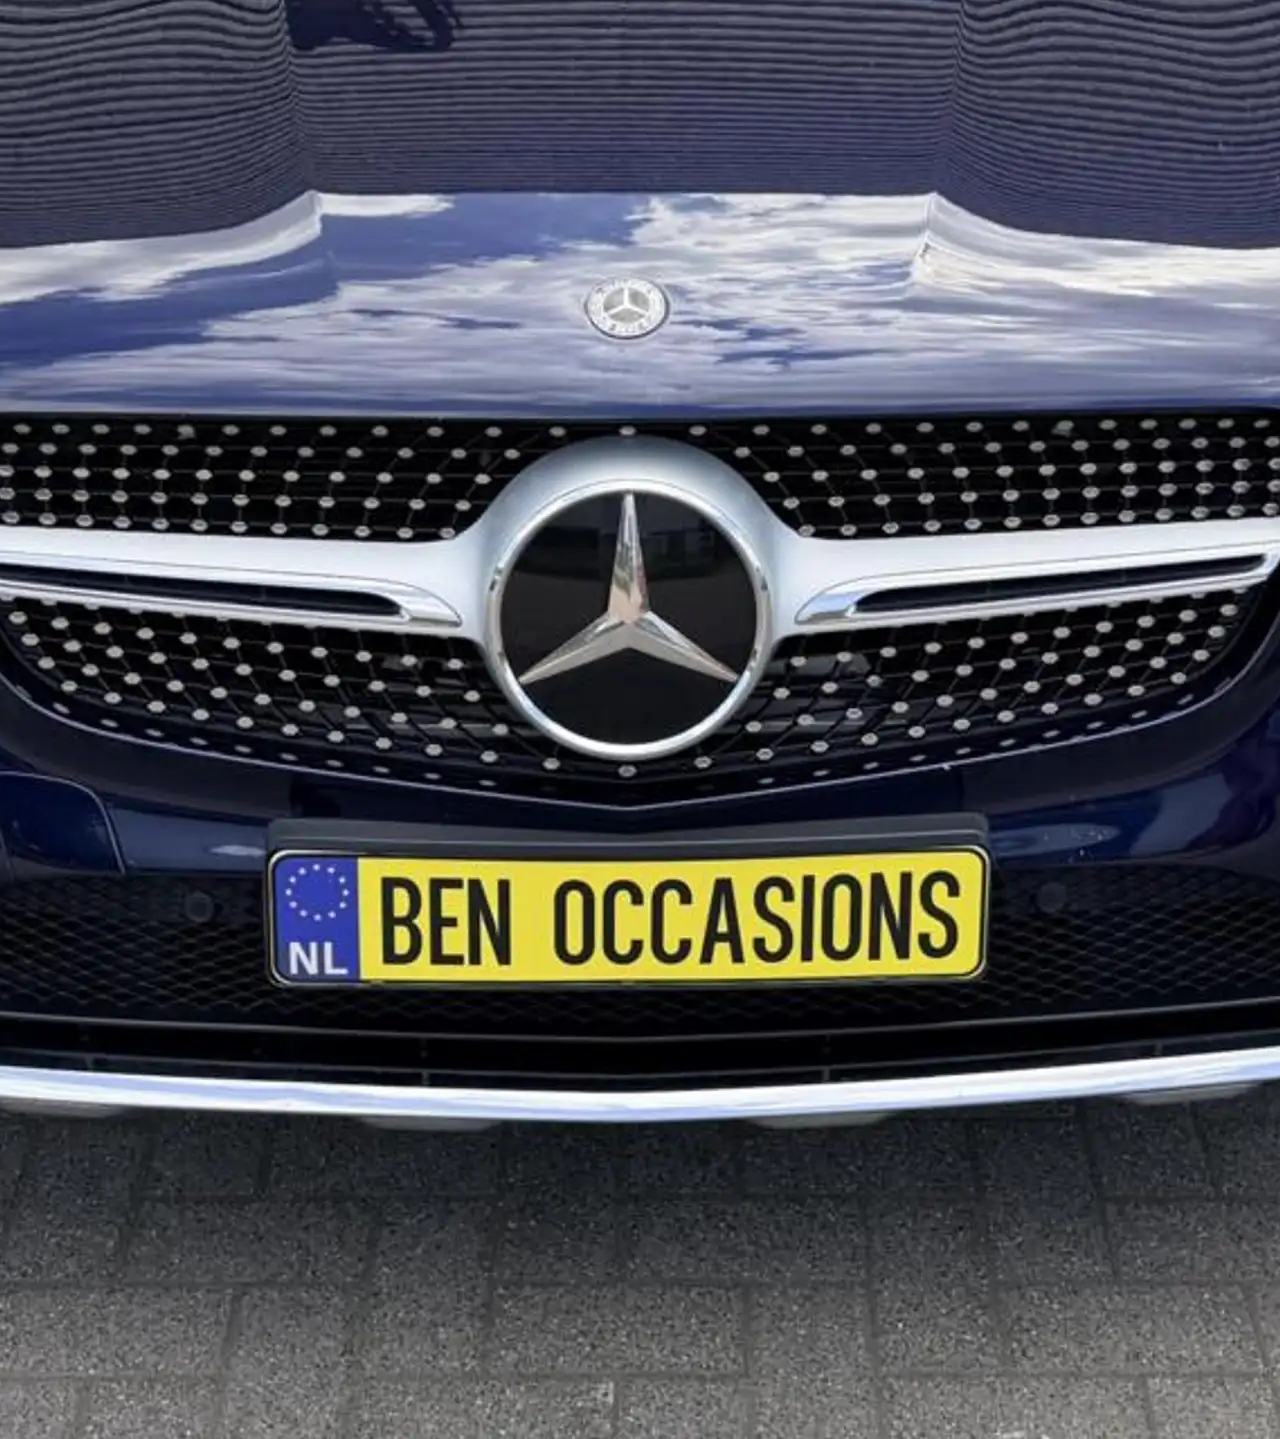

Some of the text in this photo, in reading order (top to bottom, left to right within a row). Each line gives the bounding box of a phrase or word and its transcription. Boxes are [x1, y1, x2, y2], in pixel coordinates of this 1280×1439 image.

[380, 870, 962, 966] BEN OCCASIONS
[287, 942, 348, 977] NL
